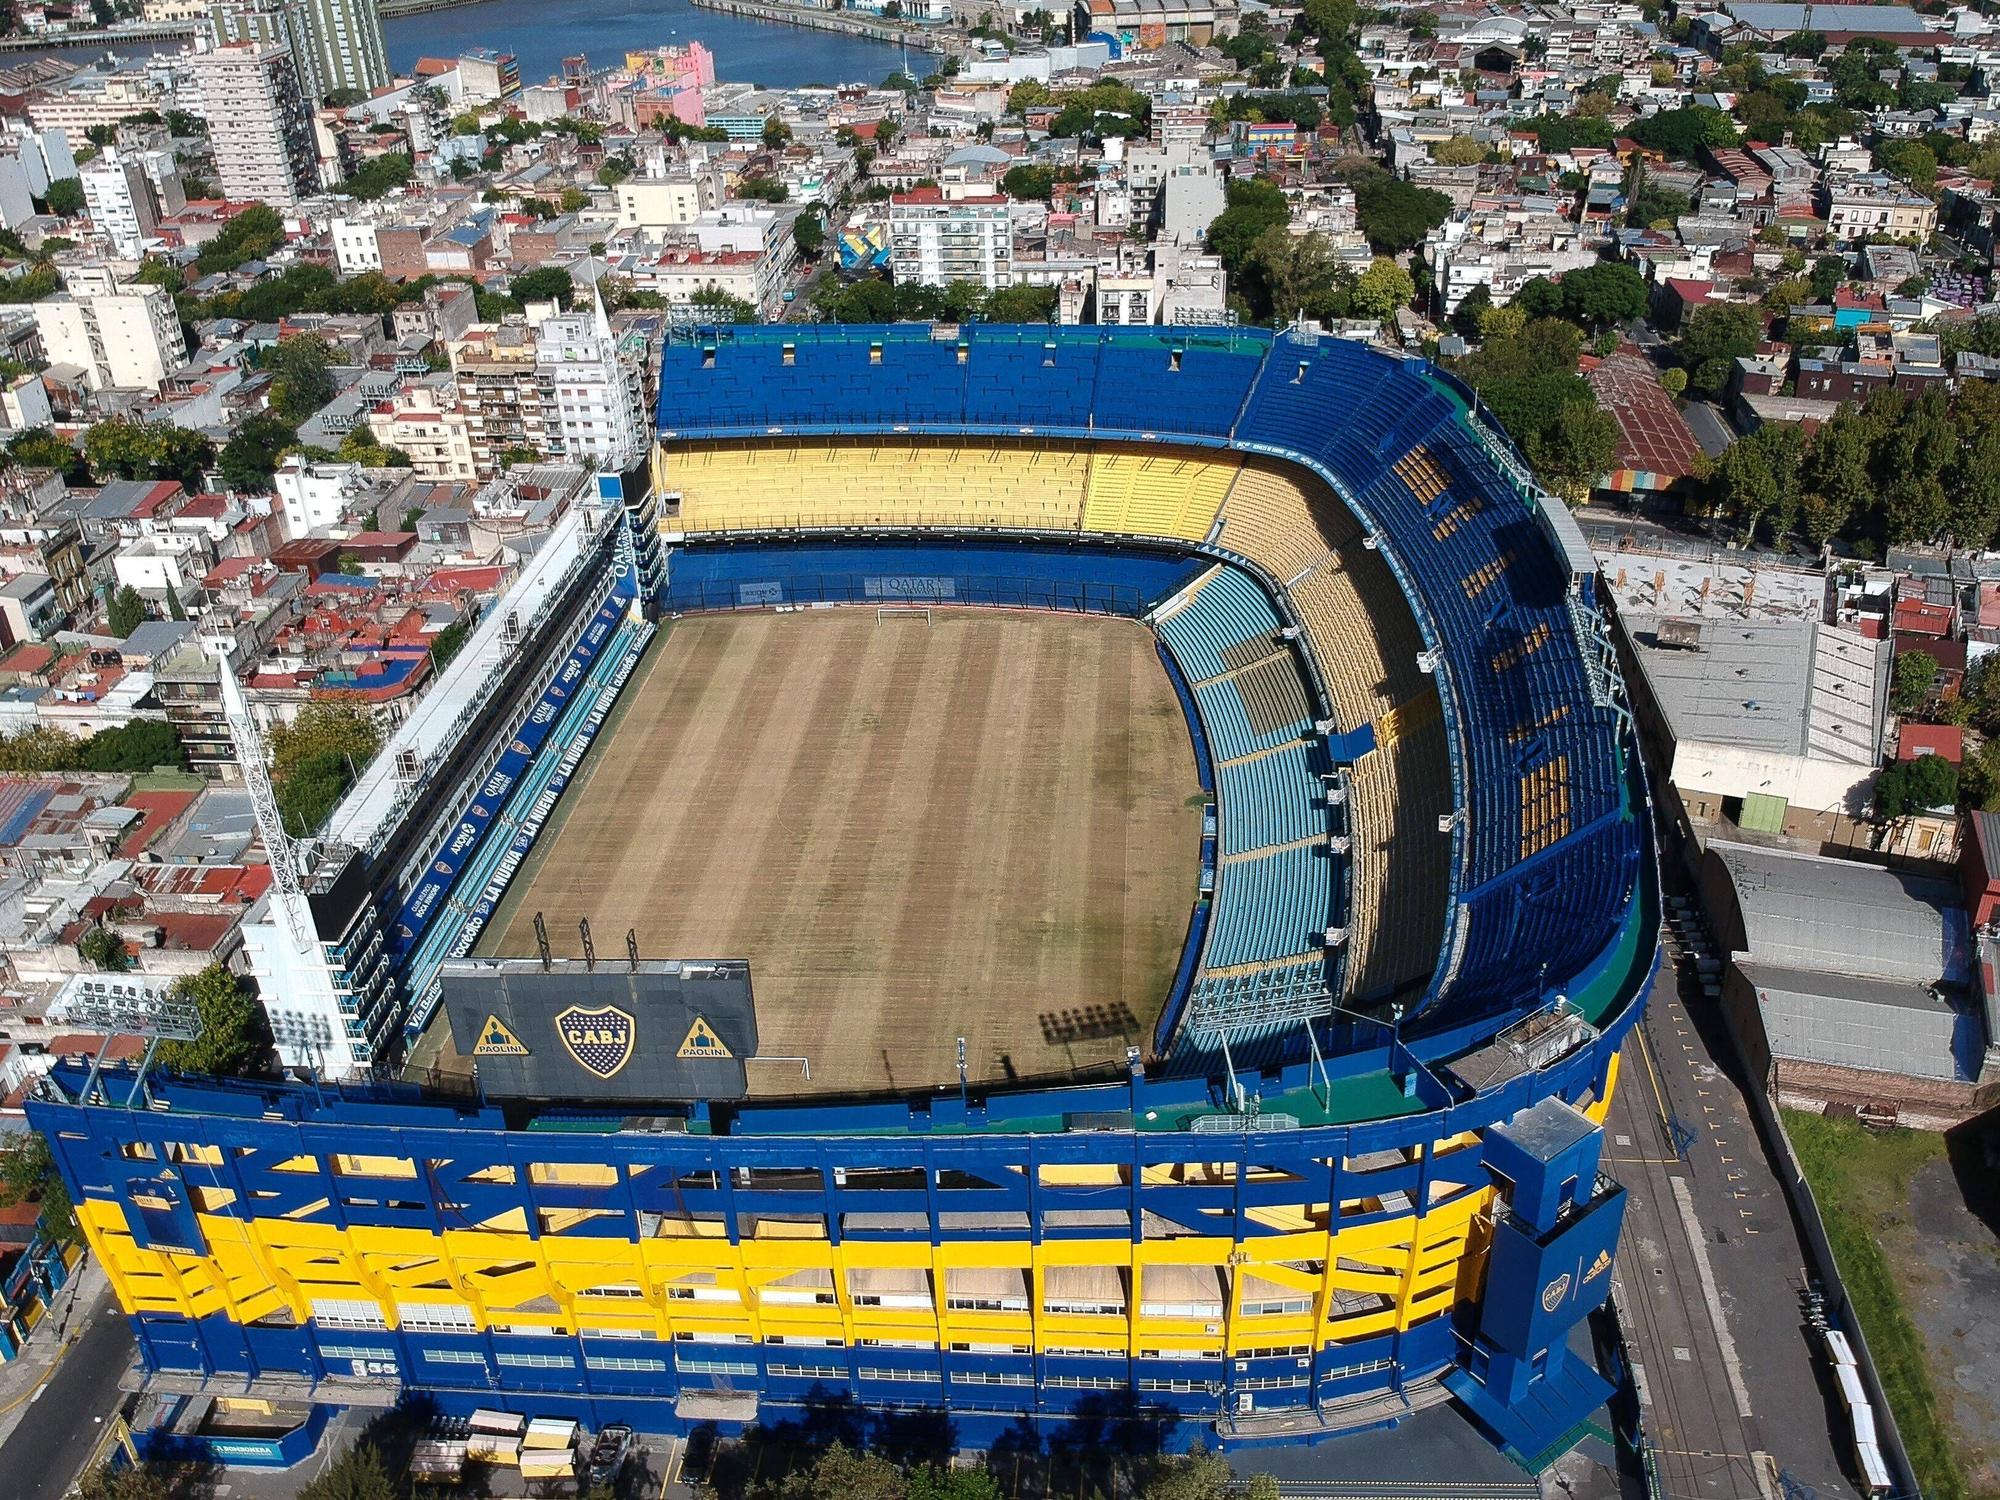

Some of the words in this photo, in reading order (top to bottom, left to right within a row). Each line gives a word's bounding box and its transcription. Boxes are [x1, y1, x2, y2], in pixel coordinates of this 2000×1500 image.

[888, 578, 935, 590] QATAR
[532, 701, 552, 724] QATAR
[589, 709, 605, 725] LA
[597, 685, 619, 713] NUEVA
[557, 762, 574, 777] LA
[566, 734, 591, 766] NUEVA
[484, 771, 506, 797] QATAR
[530, 789, 558, 825] NUEVA
[522, 820, 540, 837] LA
[450, 832, 469, 856] AXION
[483, 885, 503, 903] LA
[494, 849, 524, 889] NUEVA
[450, 917, 484, 957] tocrédito
[568, 1029, 626, 1045] CABJ
[478, 1045, 522, 1055] PAOLINI
[682, 1047, 727, 1058] PAOLINI
